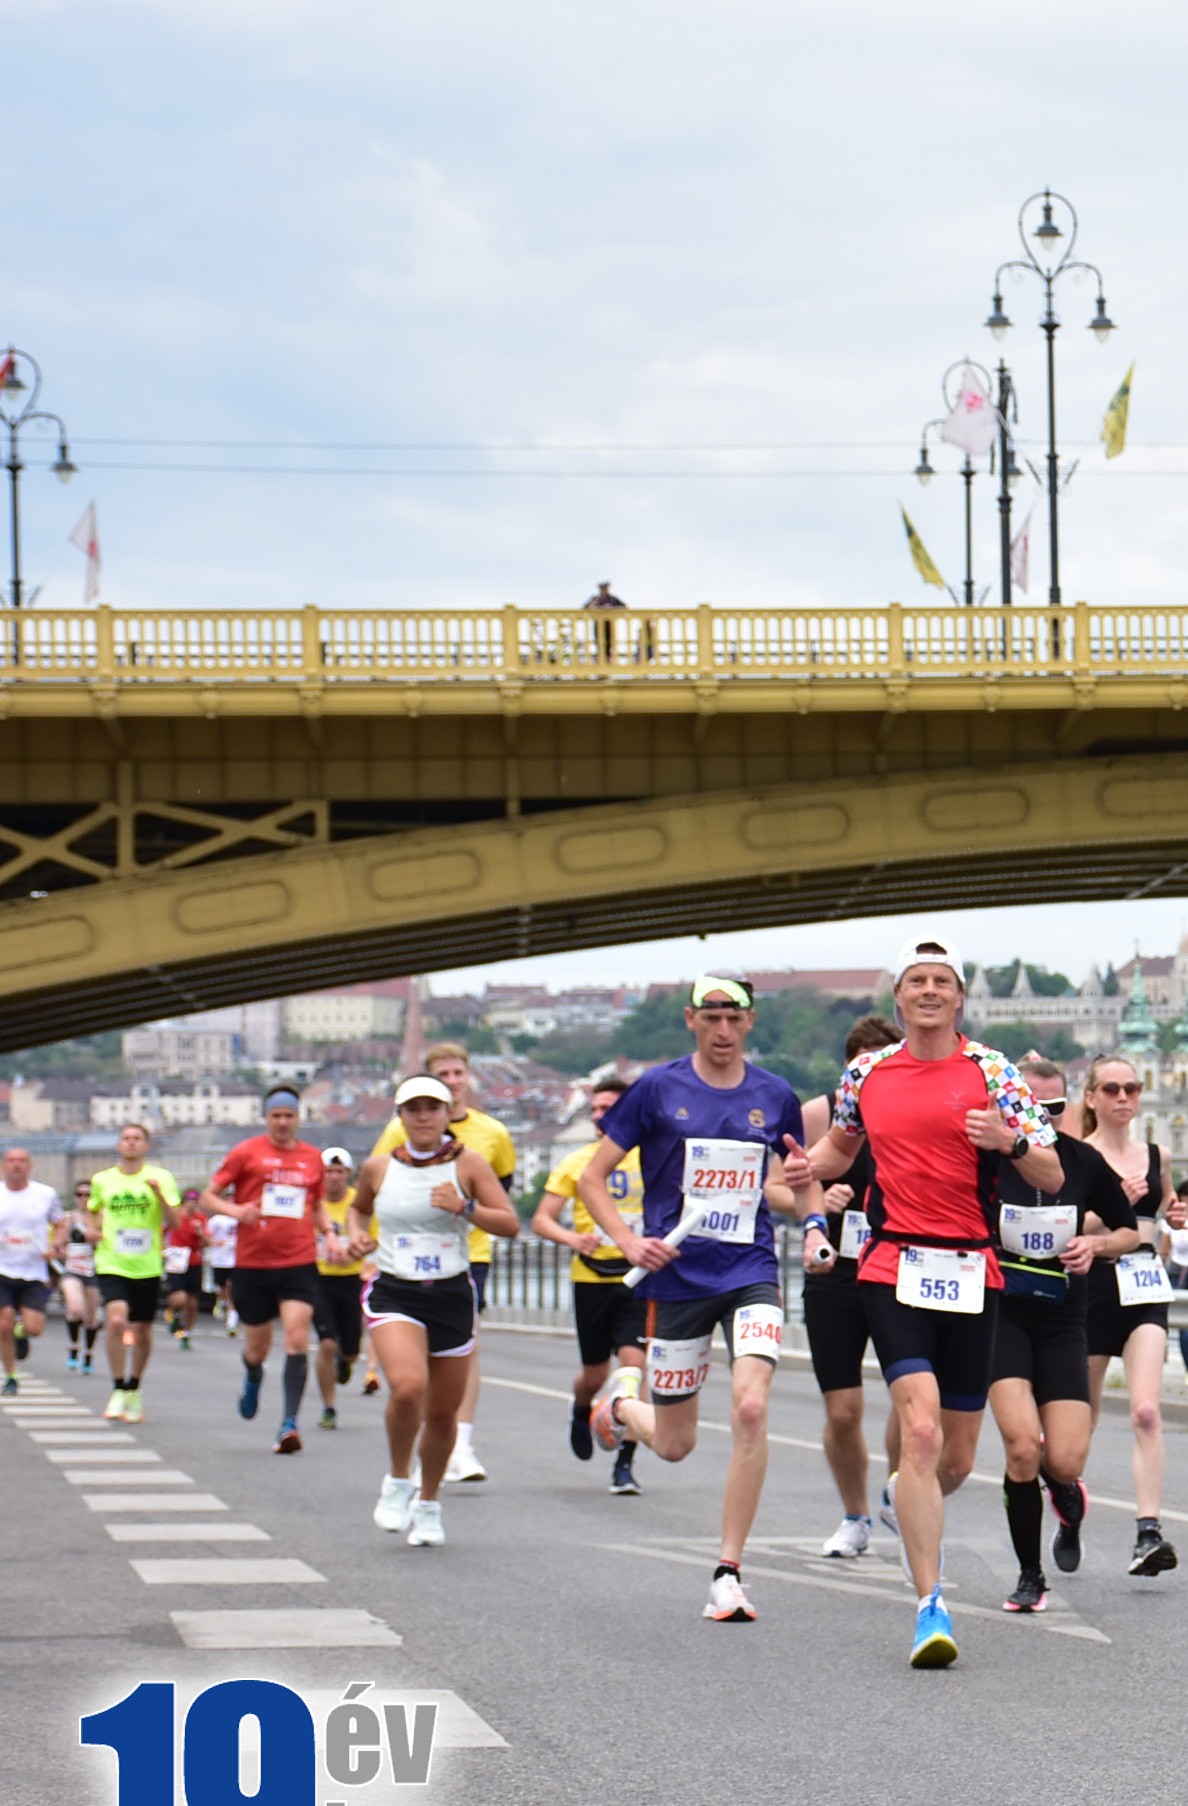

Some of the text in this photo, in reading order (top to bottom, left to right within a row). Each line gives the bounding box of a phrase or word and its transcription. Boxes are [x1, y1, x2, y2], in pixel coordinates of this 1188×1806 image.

[693, 1169, 756, 1189] 2273/1
[1021, 1232, 1054, 1250] 188
[414, 1255, 441, 1272] 764
[1133, 1269, 1162, 1287] 1214
[920, 1277, 960, 1301] 553
